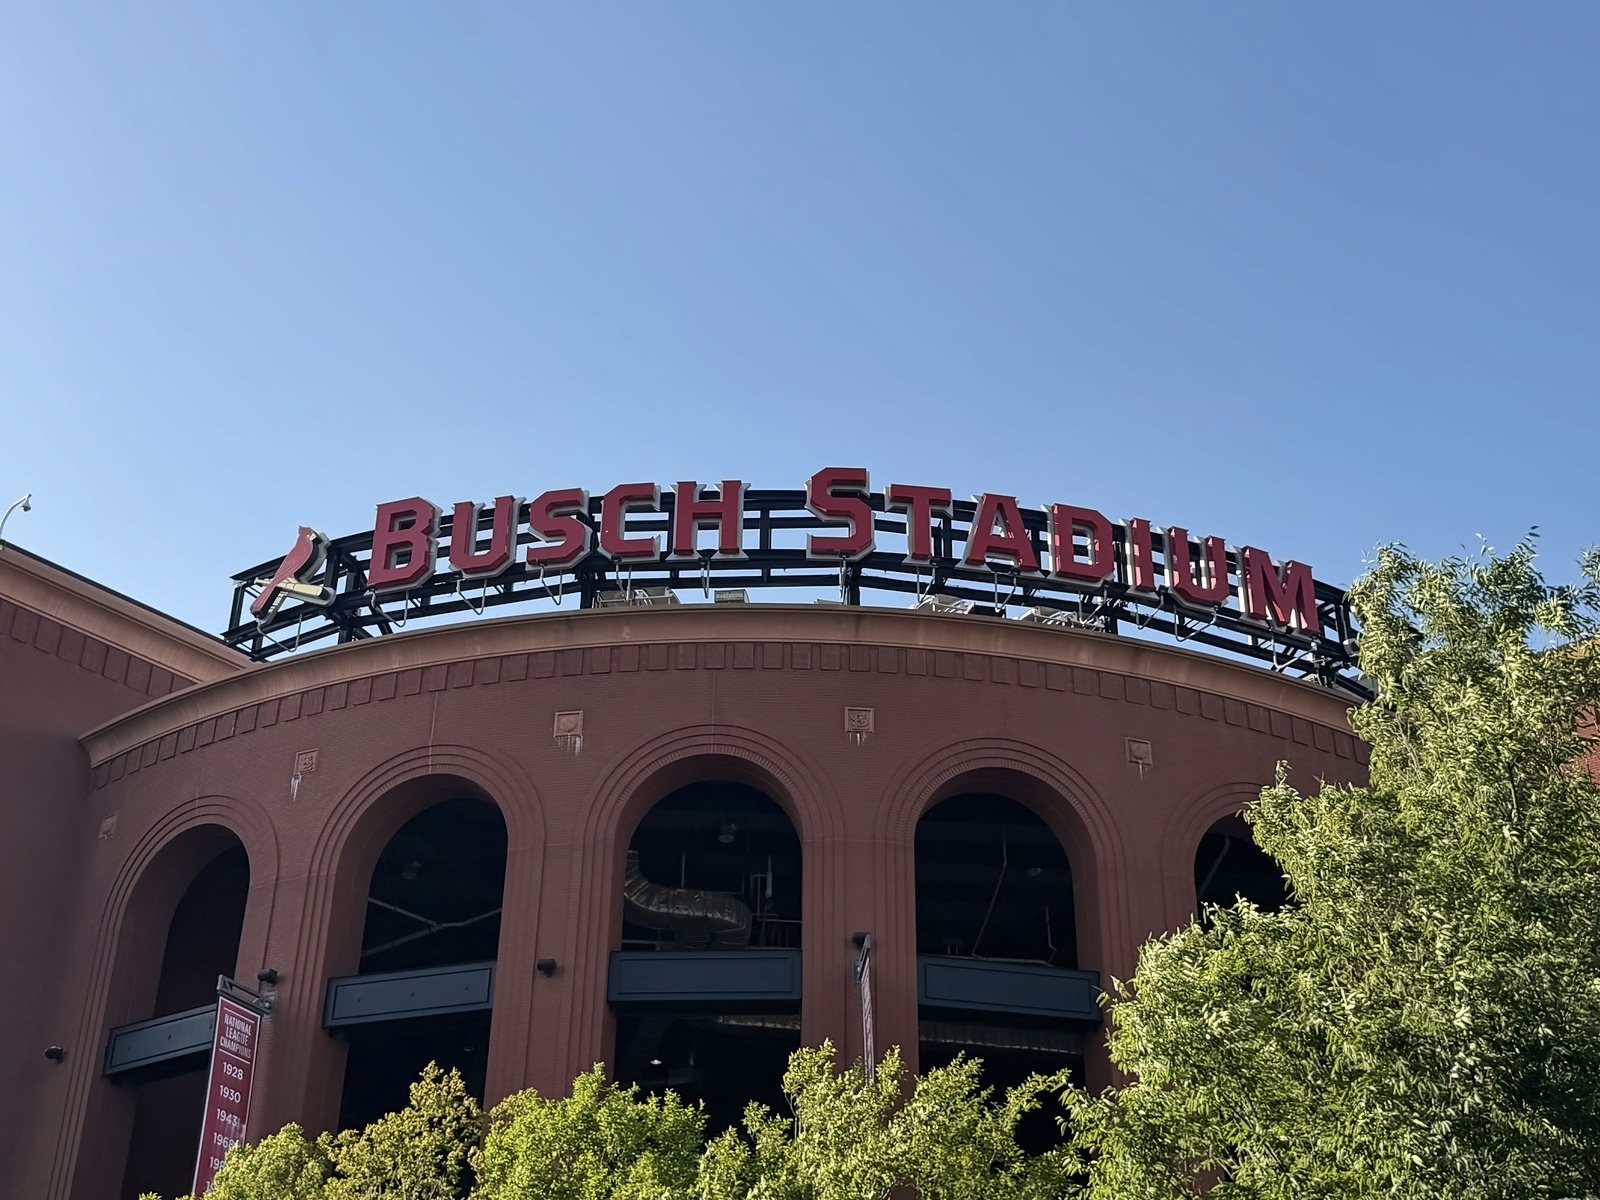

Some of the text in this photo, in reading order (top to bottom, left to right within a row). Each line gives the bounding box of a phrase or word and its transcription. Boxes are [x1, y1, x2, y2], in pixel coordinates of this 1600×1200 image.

[367, 467, 1321, 637] BUSCH STADIUM
[224, 1013, 252, 1036] NATIONAL
[225, 1026, 249, 1046] LEAGUE
[220, 1036, 252, 1059] CHAMPIONS
[223, 1062, 244, 1080] 1928
[219, 1085, 241, 1103] 1930
[216, 1108, 238, 1127] 1943
